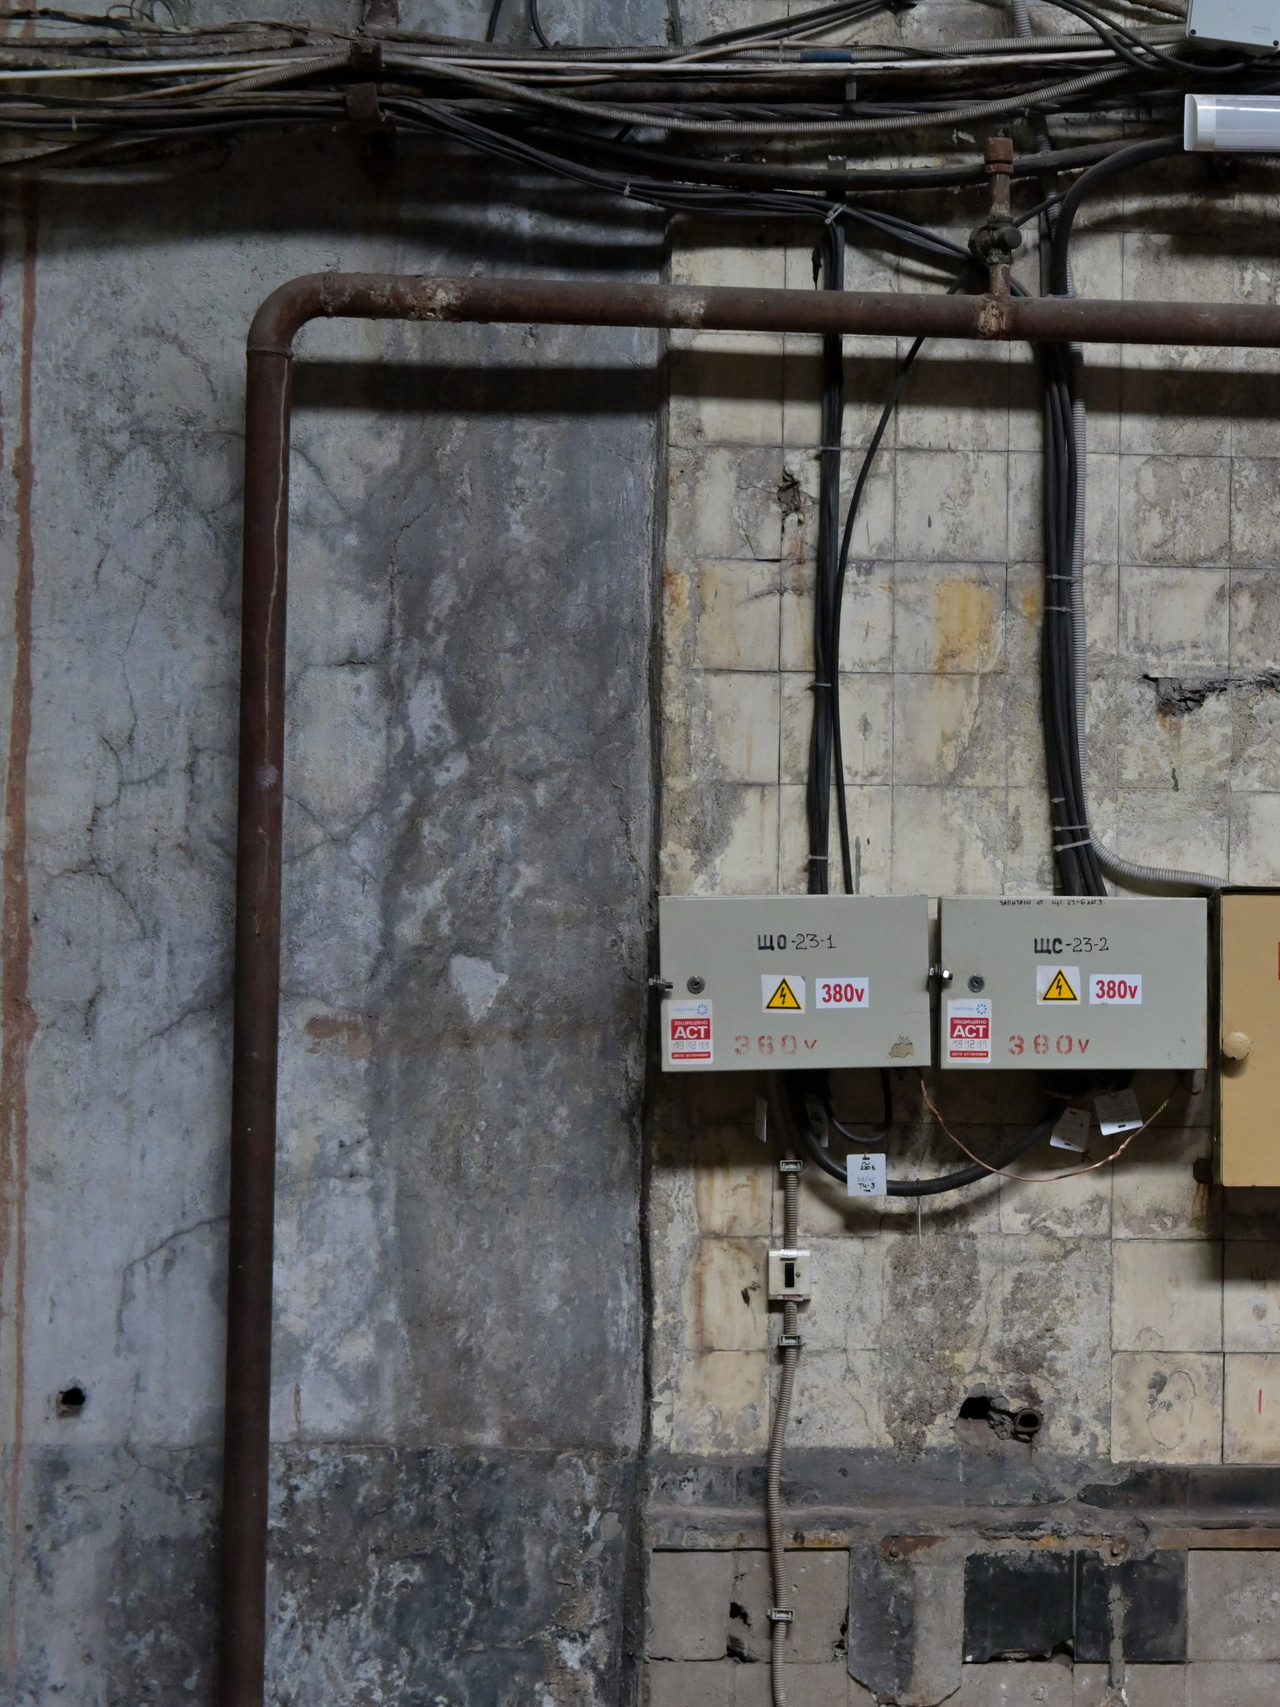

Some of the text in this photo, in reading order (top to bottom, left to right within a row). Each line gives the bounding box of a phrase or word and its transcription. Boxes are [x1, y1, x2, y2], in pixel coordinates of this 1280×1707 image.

[757, 933, 837, 951] ЩО-23-1
[1033, 937, 1109, 955] ЩС-23-2
[821, 983, 865, 1003] 380v
[1095, 979, 1138, 999] 380v
[1009, 1034, 1090, 1056] 380v
